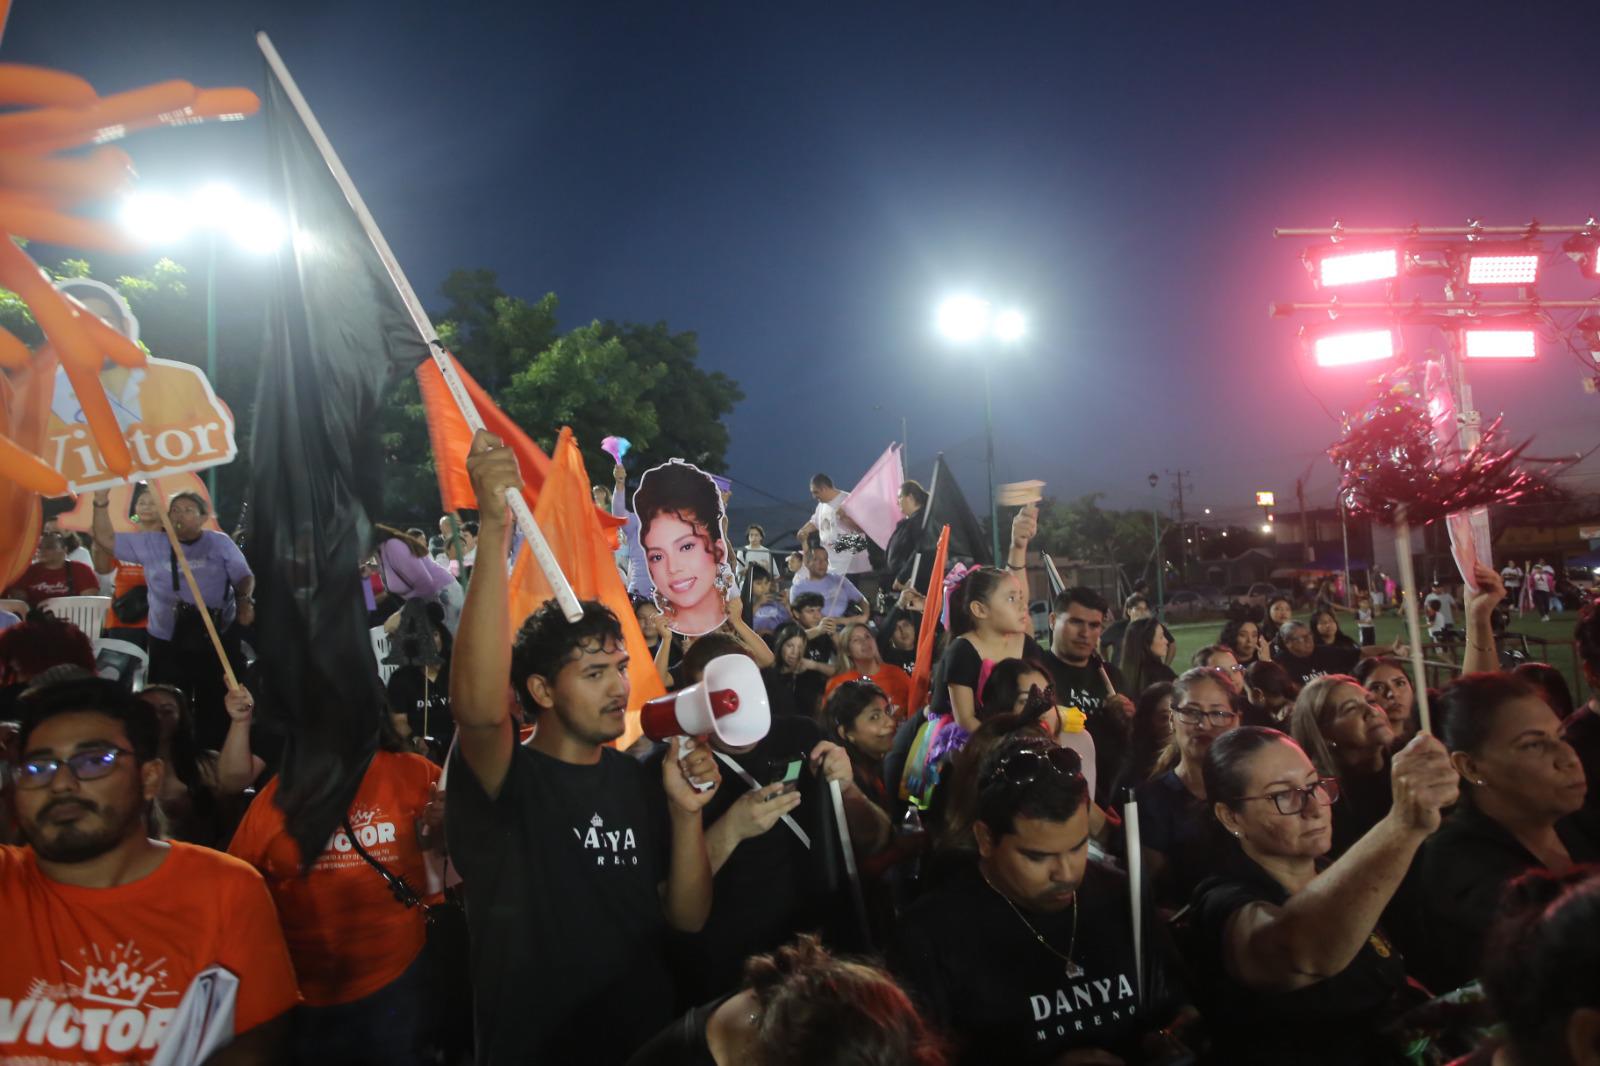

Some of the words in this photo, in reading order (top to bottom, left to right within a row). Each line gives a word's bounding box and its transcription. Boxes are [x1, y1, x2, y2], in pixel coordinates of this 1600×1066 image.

[50, 422, 220, 479] Vitor
[573, 826, 637, 852] AYA
[1029, 973, 1134, 1022] DANYA
[1035, 1004, 1136, 1041] MORENO
